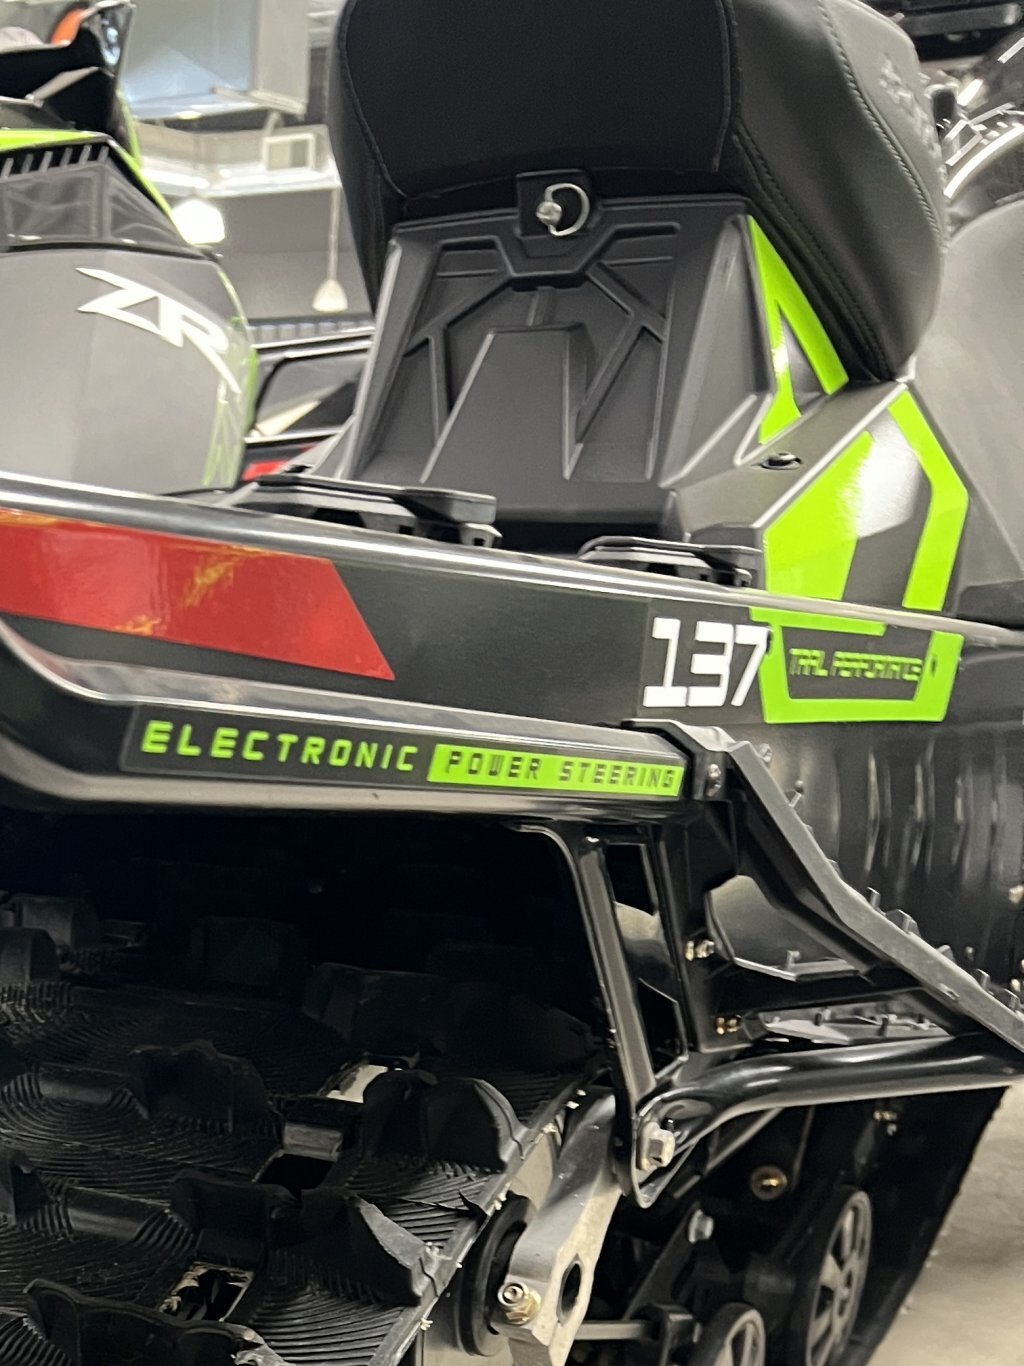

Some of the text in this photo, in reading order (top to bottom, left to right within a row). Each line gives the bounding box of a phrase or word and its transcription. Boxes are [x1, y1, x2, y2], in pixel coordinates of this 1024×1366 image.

[76, 267, 241, 393] ZR
[643, 617, 772, 707] 137
[142, 719, 418, 772] ELECTRONIC
[446, 750, 675, 789] POWER STEERING
